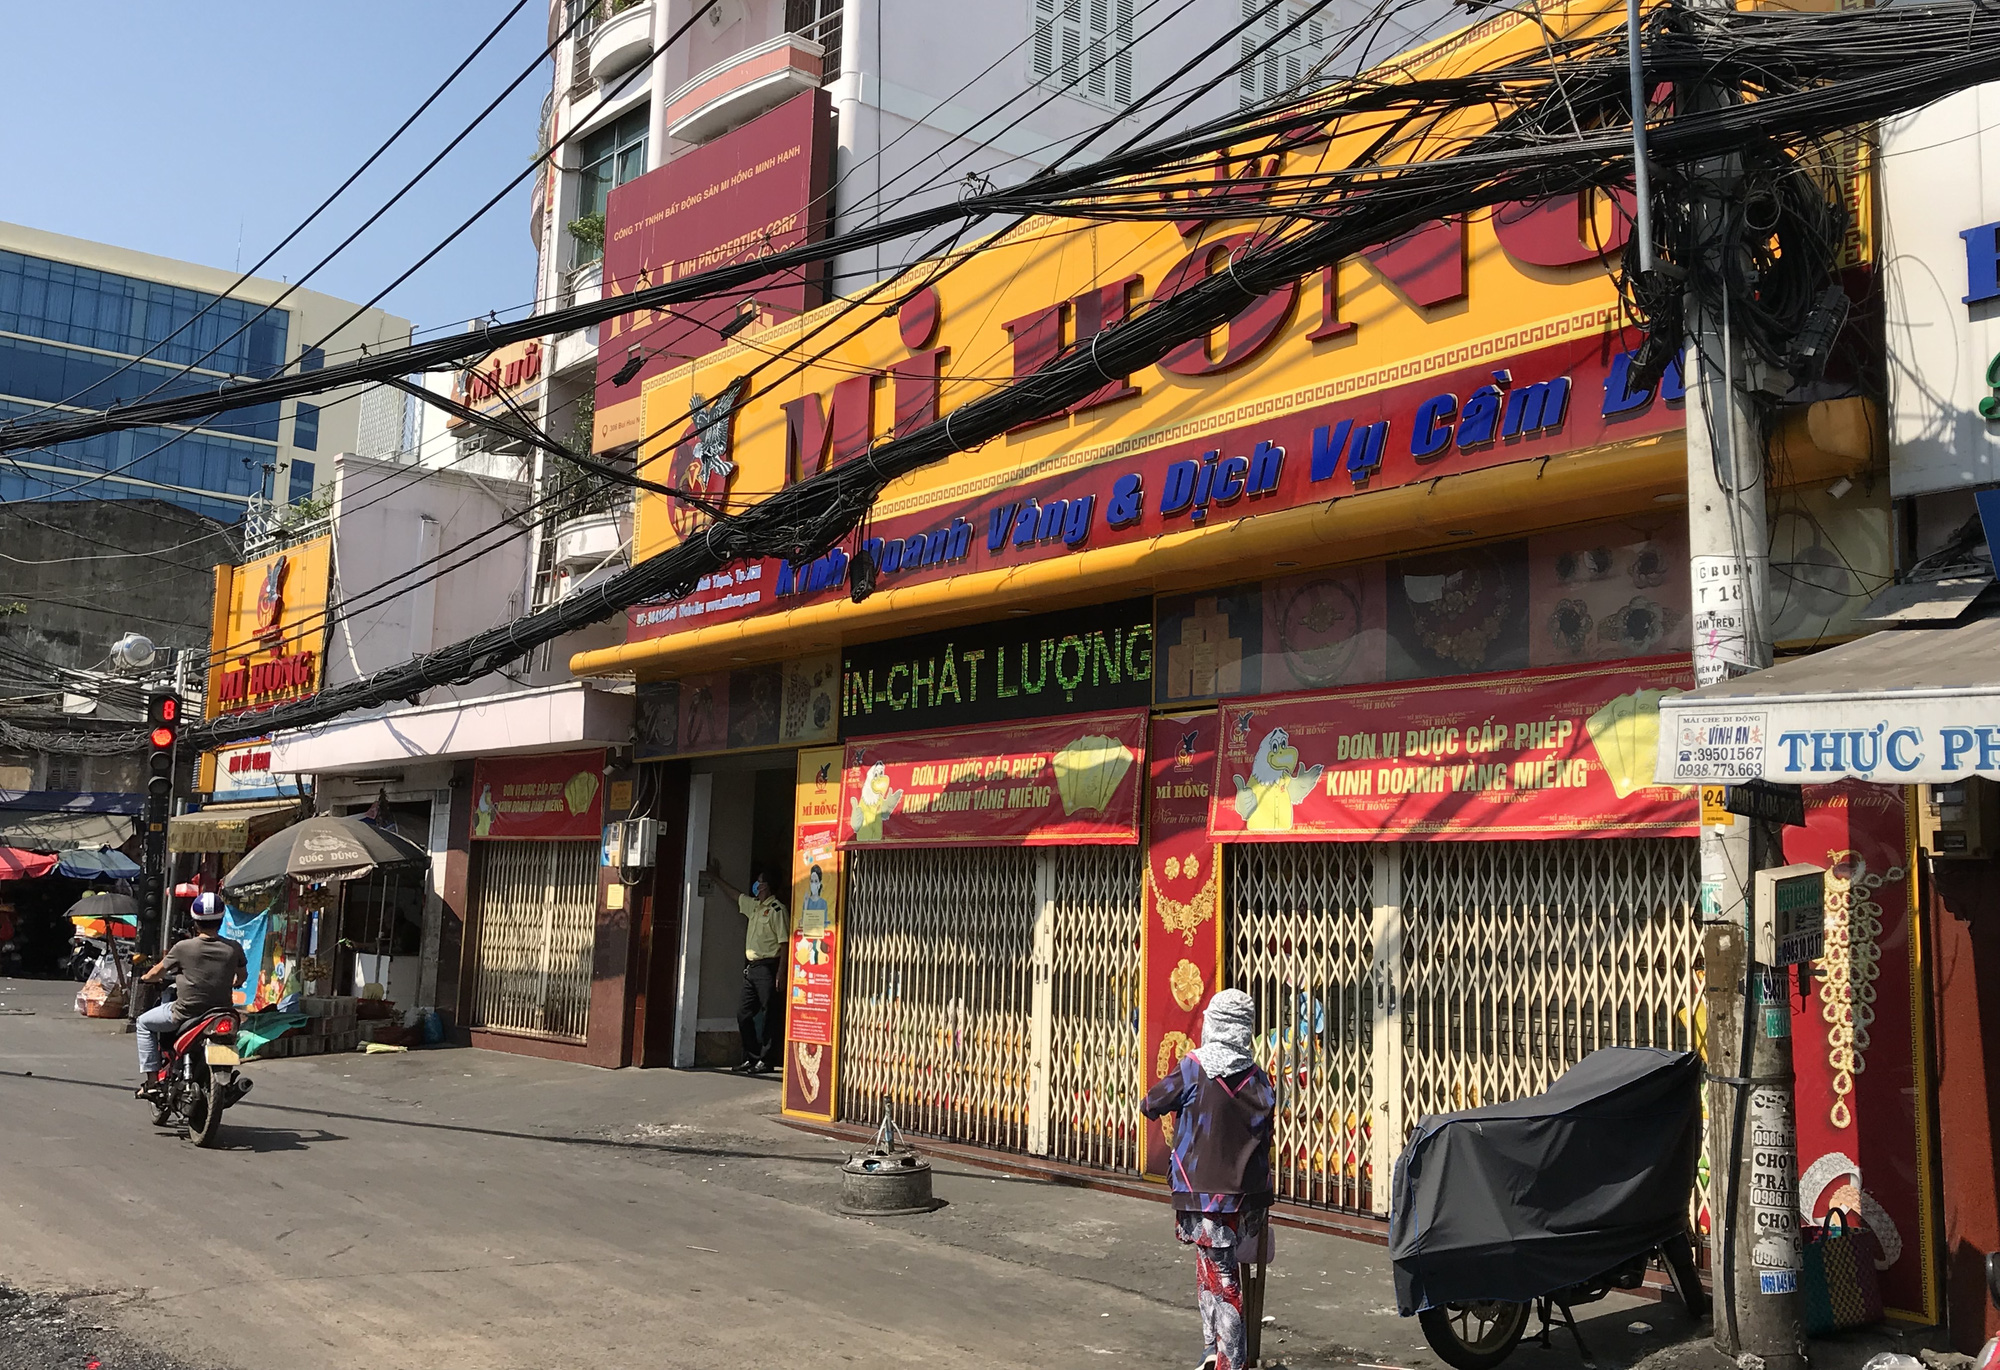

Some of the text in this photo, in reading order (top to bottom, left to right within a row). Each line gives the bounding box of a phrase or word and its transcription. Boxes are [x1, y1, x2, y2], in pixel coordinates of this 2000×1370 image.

[613, 145, 801, 242] CÔNG TY TNHH BẤT ĐỘNG SẢN MI HỒNG MINH HẠNH
[678, 257, 697, 278] MH
[699, 227, 764, 270] PROPERTIES
[766, 213, 798, 238] CORP
[987, 494, 1097, 553] Vàng
[1106, 473, 1145, 526] &
[1160, 439, 1287, 523] Dịch
[1310, 418, 1390, 486] Vụ
[1410, 368, 1572, 457] Cầm
[996, 623, 1153, 703] LƯỢNG
[163, 700, 176, 720] 8
[1338, 714, 1573, 763] ĐƠN VỊ ĐƯỢC CẤP PHÉP
[1708, 724, 1733, 745] VĨNH
[1735, 726, 1750, 744] AN
[1778, 720, 1922, 780] THỰC
[911, 753, 1047, 789] ĐƠN VỊ ĐƯỢC CẤP PHÉP
[1326, 752, 1587, 796] KINH DOANH VÀNG MIẾNG
[1677, 763, 1763, 777] 0938.773.663
[902, 780, 1051, 814] KINH DOANH VÀNG MIẾNG
[1828, 793, 1849, 808] tin
[1754, 1169, 1788, 1190] TRẢ
